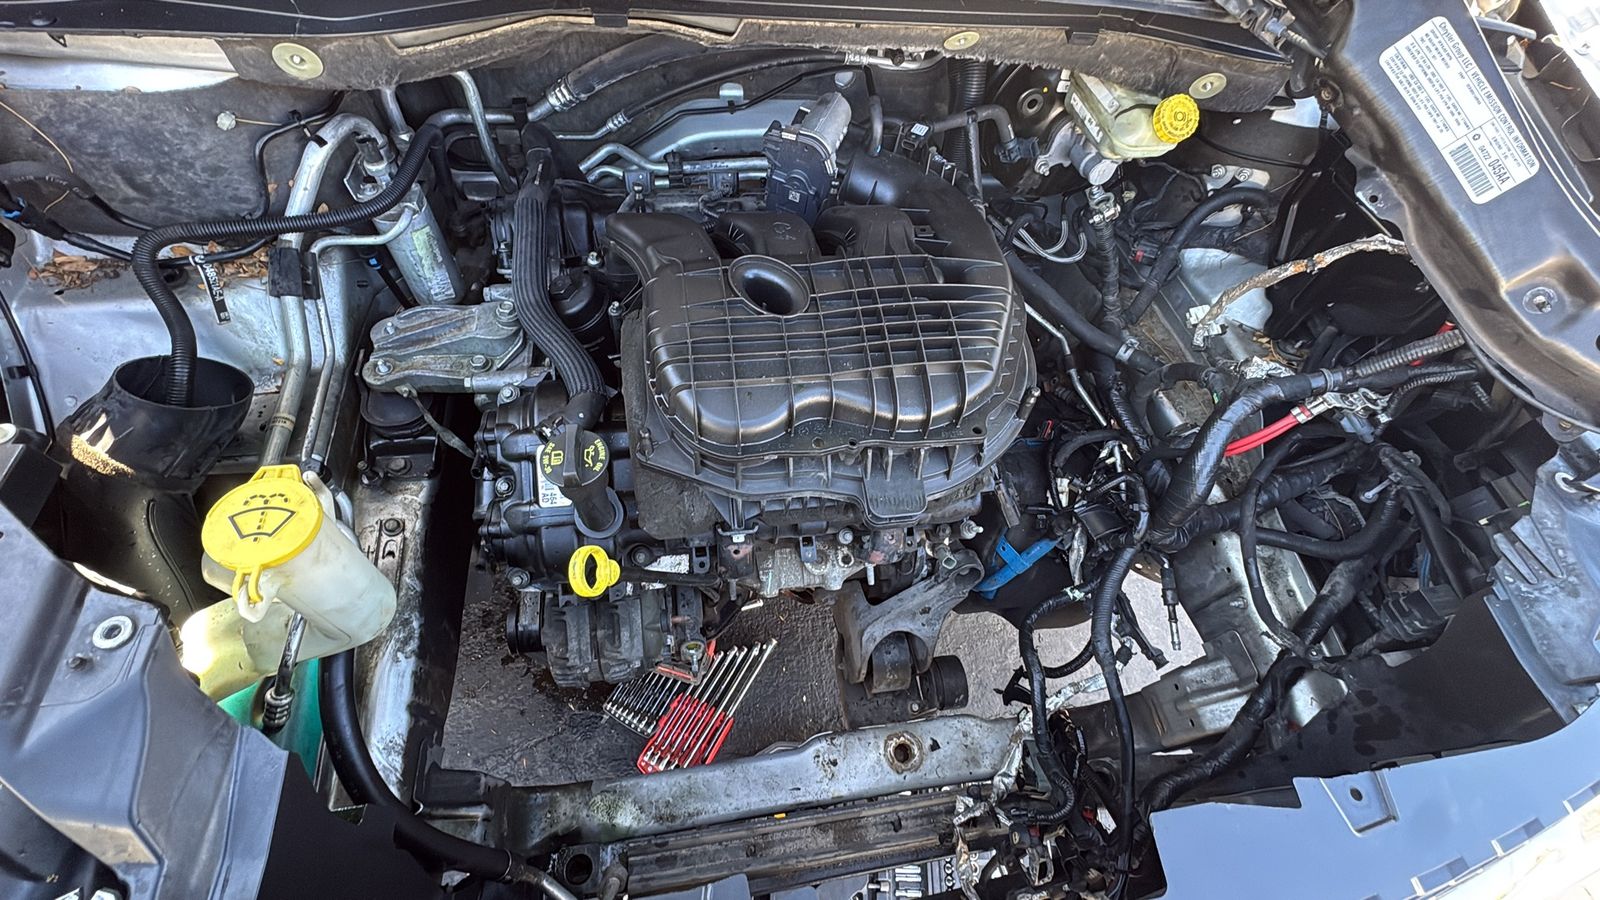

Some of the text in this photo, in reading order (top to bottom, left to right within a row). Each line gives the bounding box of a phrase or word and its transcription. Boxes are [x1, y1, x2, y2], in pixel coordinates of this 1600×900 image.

[1436, 21, 1472, 68] Chrysler Group LLC
[1470, 70, 1487, 91] VEHICLE
[1482, 90, 1502, 114] EMISSION
[1497, 112, 1516, 135] CONTROL
[1511, 134, 1537, 168] INFORMATION
[1477, 144, 1492, 161] 04722
[1487, 157, 1511, 185] 045AA
[593, 439, 605, 472] ENGINE OIL
